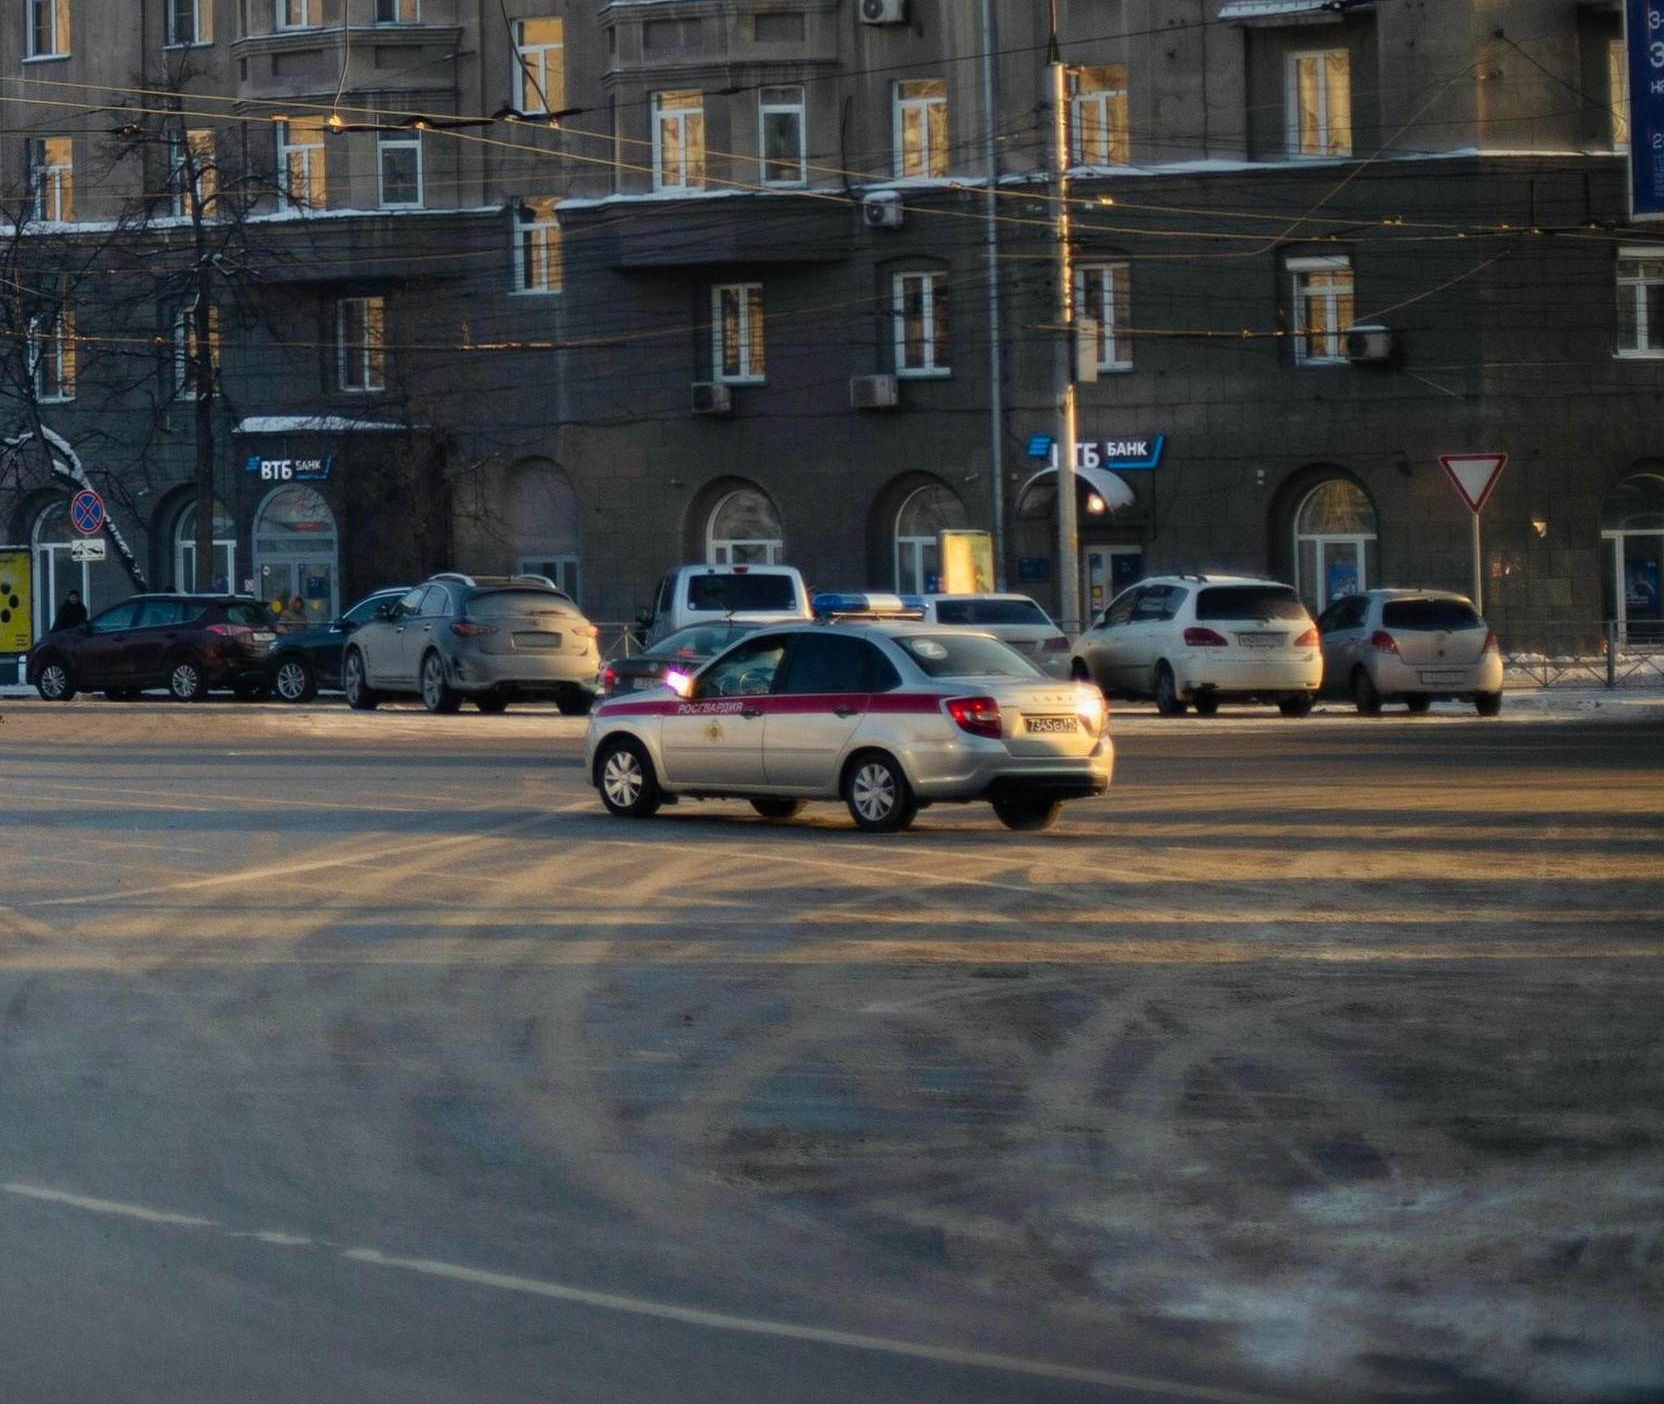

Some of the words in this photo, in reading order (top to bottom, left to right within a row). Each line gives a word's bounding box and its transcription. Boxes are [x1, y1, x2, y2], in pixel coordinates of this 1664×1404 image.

[1051, 442, 1100, 469] ТБ
[1107, 441, 1149, 457] БАНК
[261, 459, 293, 480] ВТБ
[295, 459, 322, 471] БАНК
[677, 702, 744, 714] РОСГВАРДИЯ
